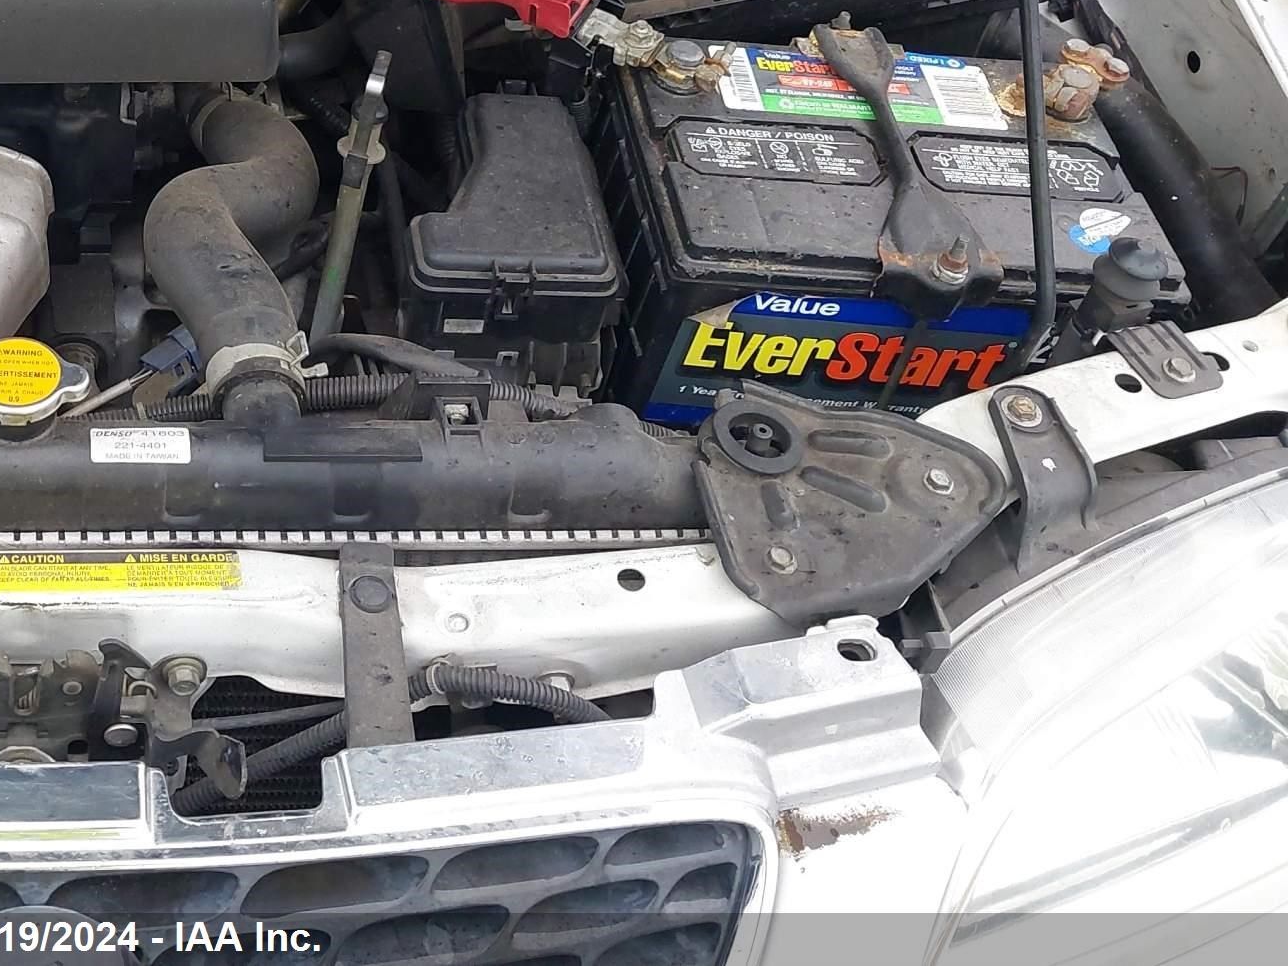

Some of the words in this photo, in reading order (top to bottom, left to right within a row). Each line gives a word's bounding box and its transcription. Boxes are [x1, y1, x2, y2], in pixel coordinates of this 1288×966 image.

[718, 127, 772, 139] DANGER
[784, 131, 835, 142] POISON
[754, 294, 840, 317] Value
[3, 349, 43, 357] WARNING
[683, 322, 1007, 390] EverStart
[692, 385, 718, 396] Yea
[114, 441, 167, 449] 221-4401
[146, 452, 179, 460] TAIWAN
[11, 554, 65, 564] CAUTION
[140, 553, 169, 563] MISE
[172, 553, 188, 563] EN
[191, 553, 233, 562] GARDE
